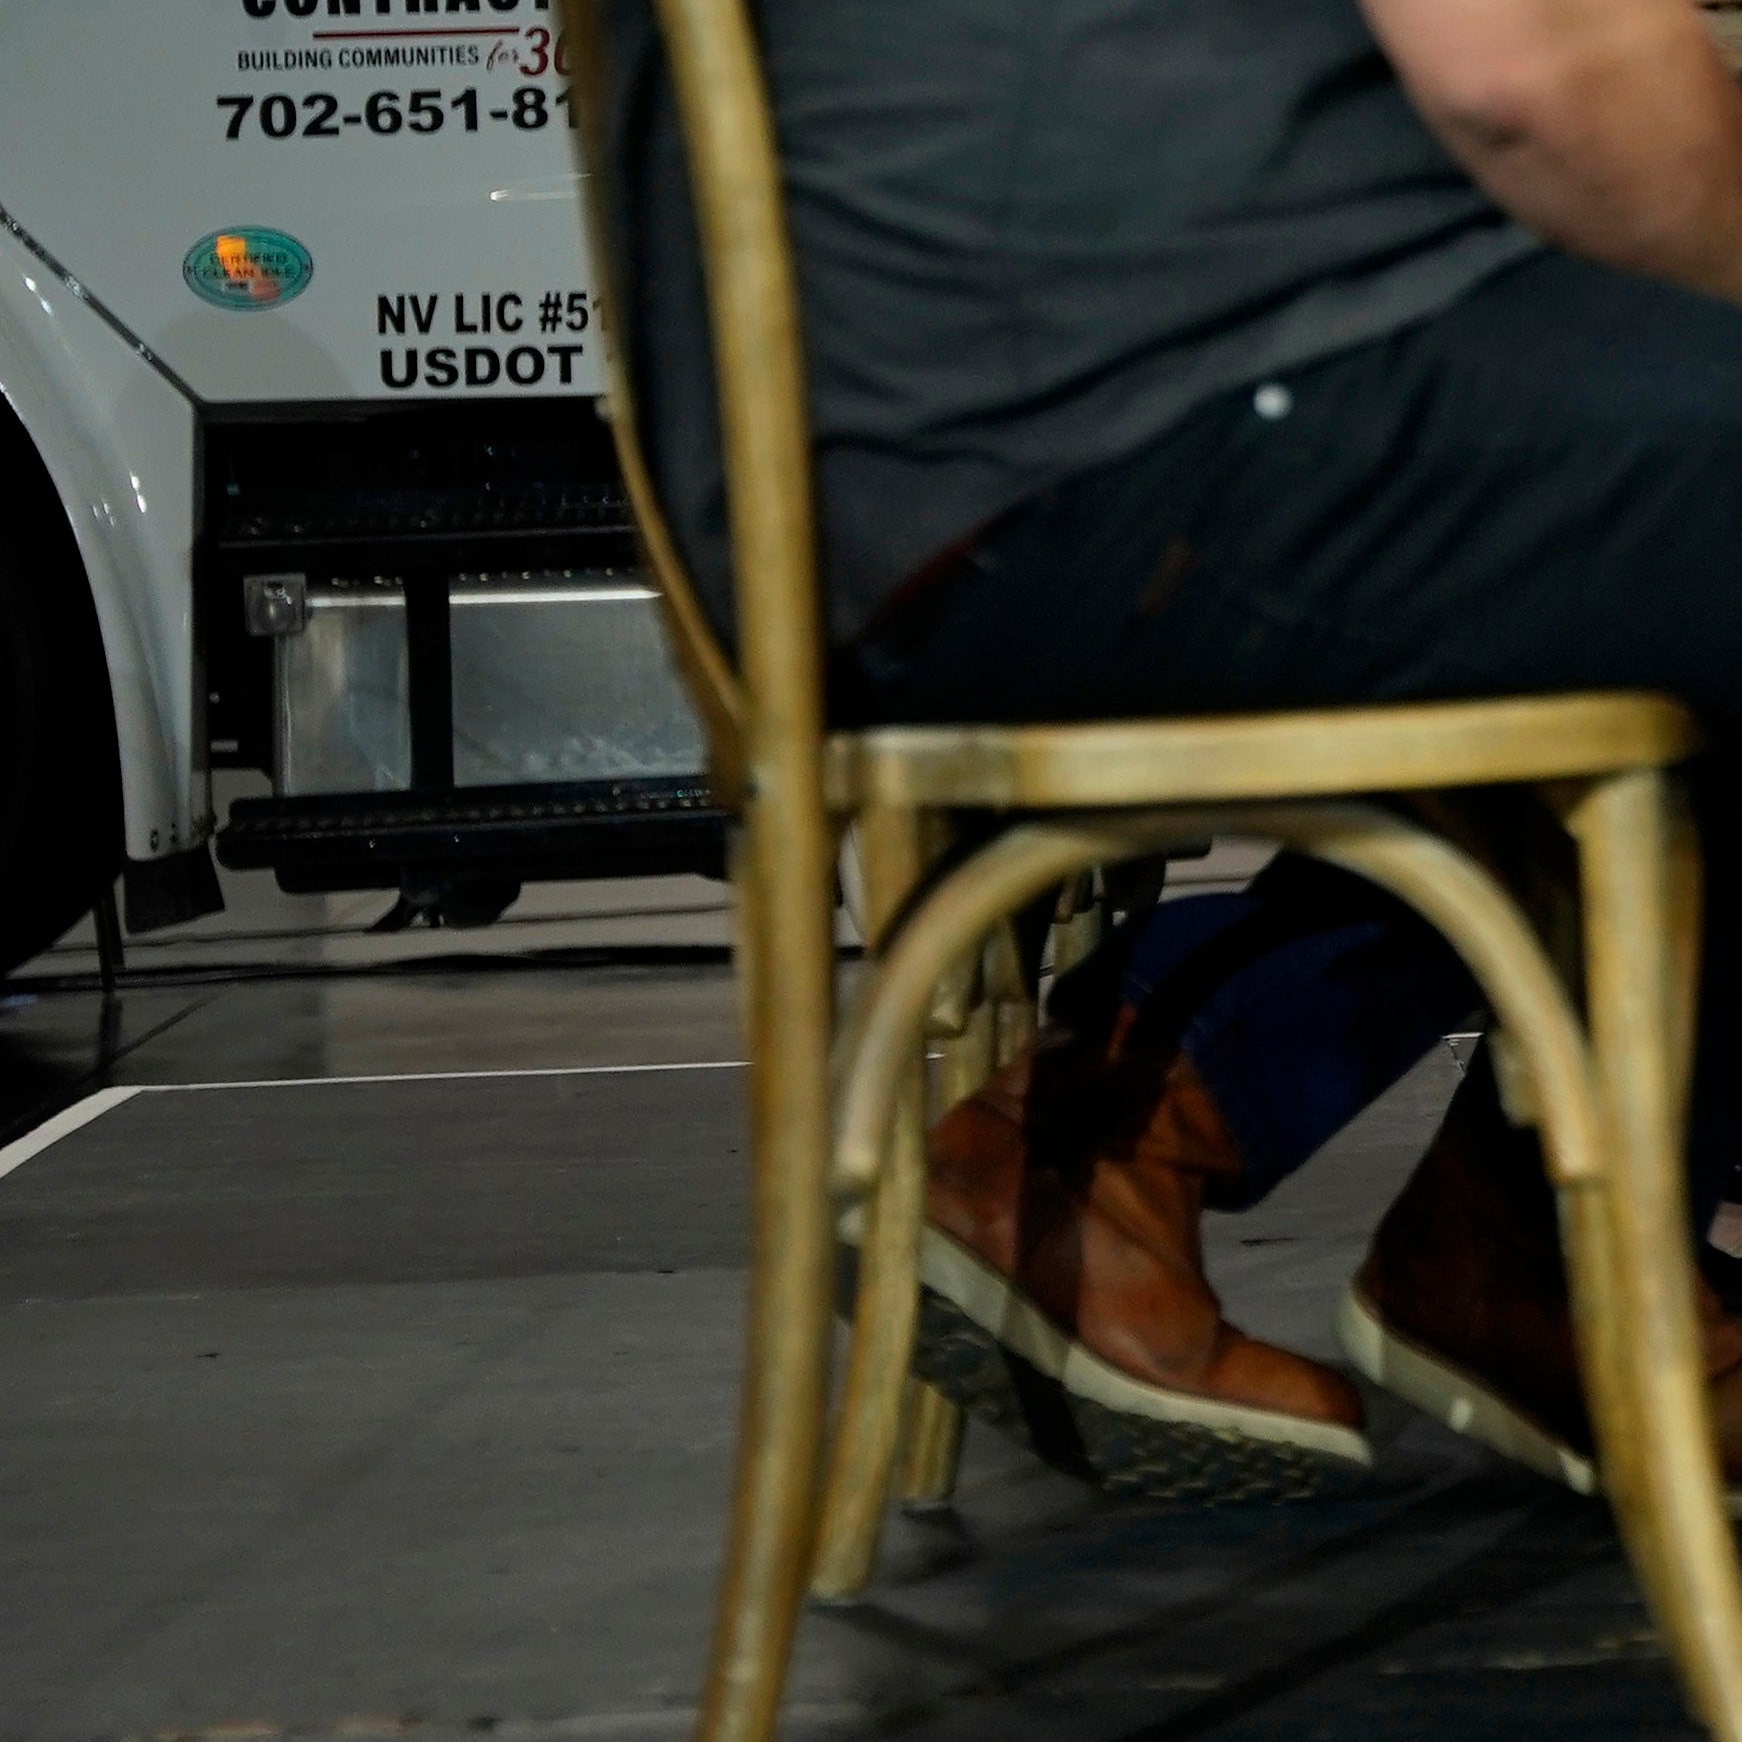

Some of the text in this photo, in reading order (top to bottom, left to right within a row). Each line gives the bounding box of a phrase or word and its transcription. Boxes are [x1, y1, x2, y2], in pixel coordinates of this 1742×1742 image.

[238, 49, 332, 72] BUILDING
[339, 44, 479, 70] COMMUNITIES
[377, 294, 438, 335] NV
[455, 292, 523, 334] LIC
[379, 344, 584, 389] USDOT
